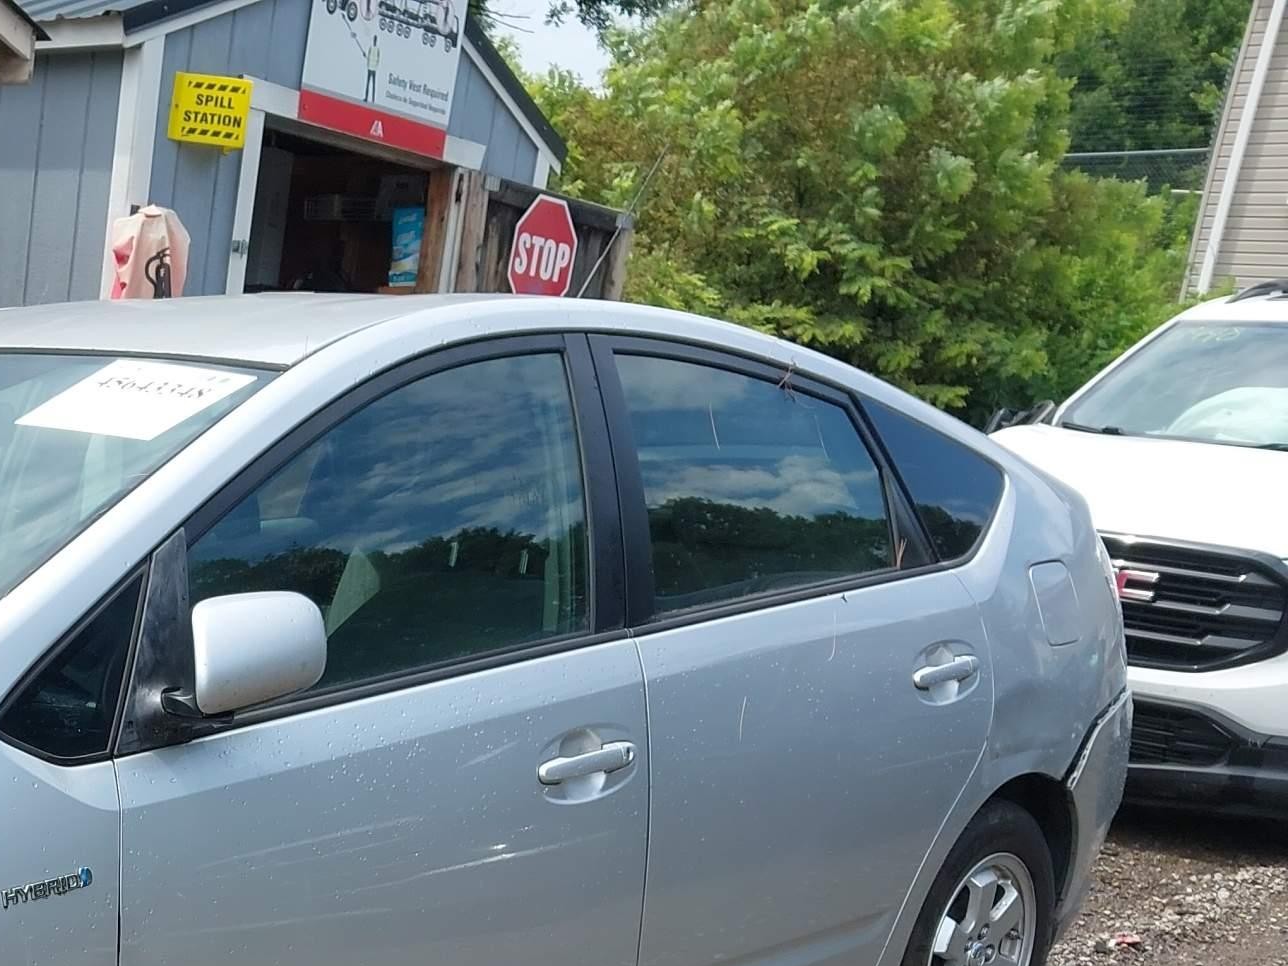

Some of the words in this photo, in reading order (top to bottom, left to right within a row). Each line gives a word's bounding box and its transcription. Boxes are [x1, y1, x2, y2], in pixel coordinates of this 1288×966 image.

[388, 72, 408, 91] Safety
[409, 79, 423, 93] Vest
[196, 93, 234, 109] SPILL
[183, 110, 242, 128] STATION
[514, 232, 570, 282] STOP
[1, 873, 80, 908] HYBRID
